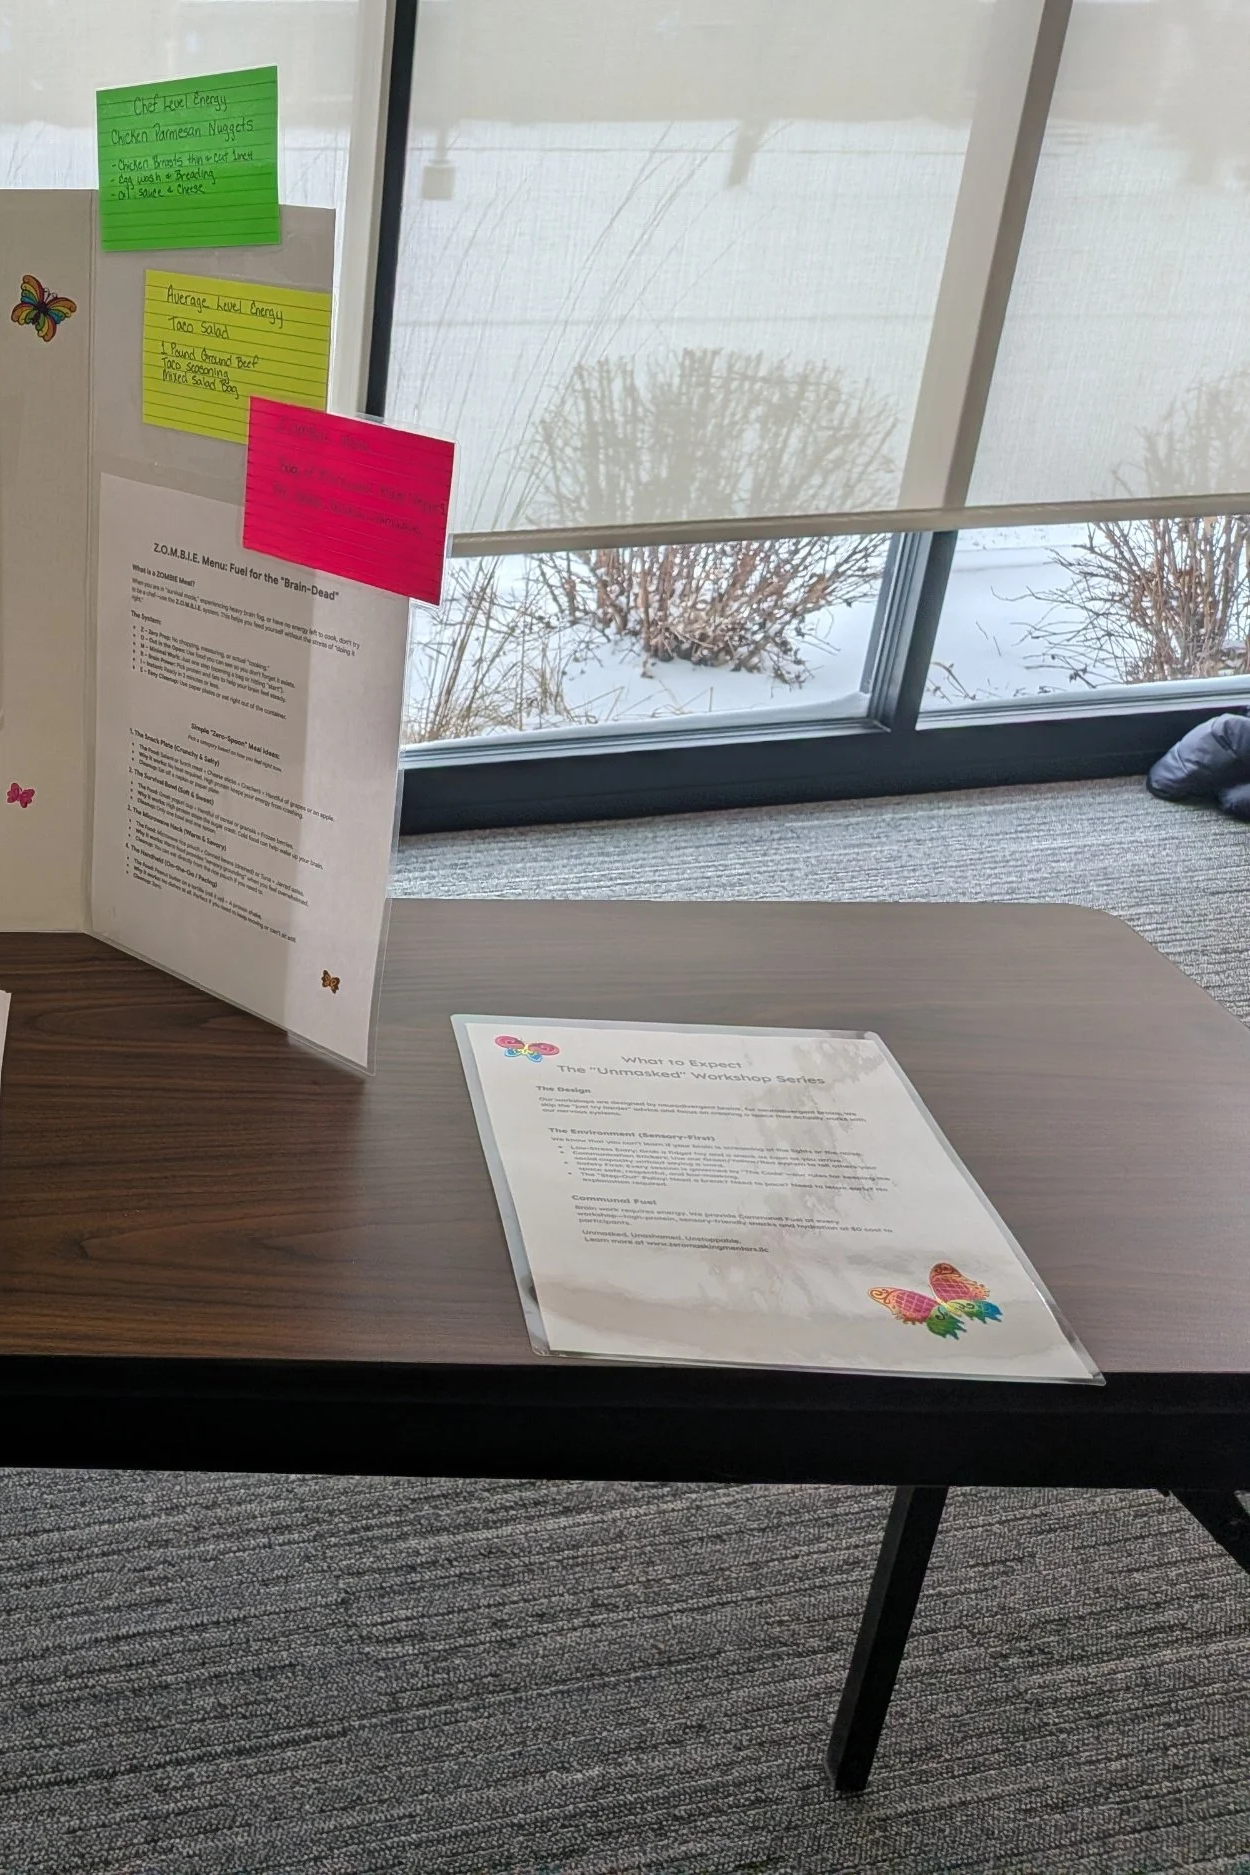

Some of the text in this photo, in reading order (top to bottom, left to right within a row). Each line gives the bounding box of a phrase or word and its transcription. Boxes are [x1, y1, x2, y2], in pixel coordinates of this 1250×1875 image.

[134, 92, 227, 115] Chef Level Energy
[111, 117, 253, 145] Chicken Parmesan Nuggets
[187, 153, 202, 165] thin
[137, 171, 161, 183] wash
[175, 168, 215, 184] Breading
[139, 188, 165, 197] sauce
[167, 284, 283, 329] Average Level Energy
[168, 316, 229, 339] Taco Salad
[161, 341, 259, 368] 1 Pound Ground Beef
[162, 357, 181, 370] Taco
[220, 380, 239, 399] Bag
[132, 563, 146, 574] What
[146, 567, 152, 576] is
[155, 570, 178, 583] ZOMBIE
[178, 576, 195, 587] Meal?
[153, 542, 339, 601] Z.O.M.B.I.E. Menu: Fuel for the "Brain-Dead"
[620, 1055, 742, 1069] What to Expect
[556, 1064, 826, 1086] The "Unmasked" Workshop Series
[556, 1086, 592, 1095] Design
[569, 1128, 636, 1138] Environment
[637, 1132, 716, 1142] (Sensory-First)
[571, 1194, 631, 1204] Communal
